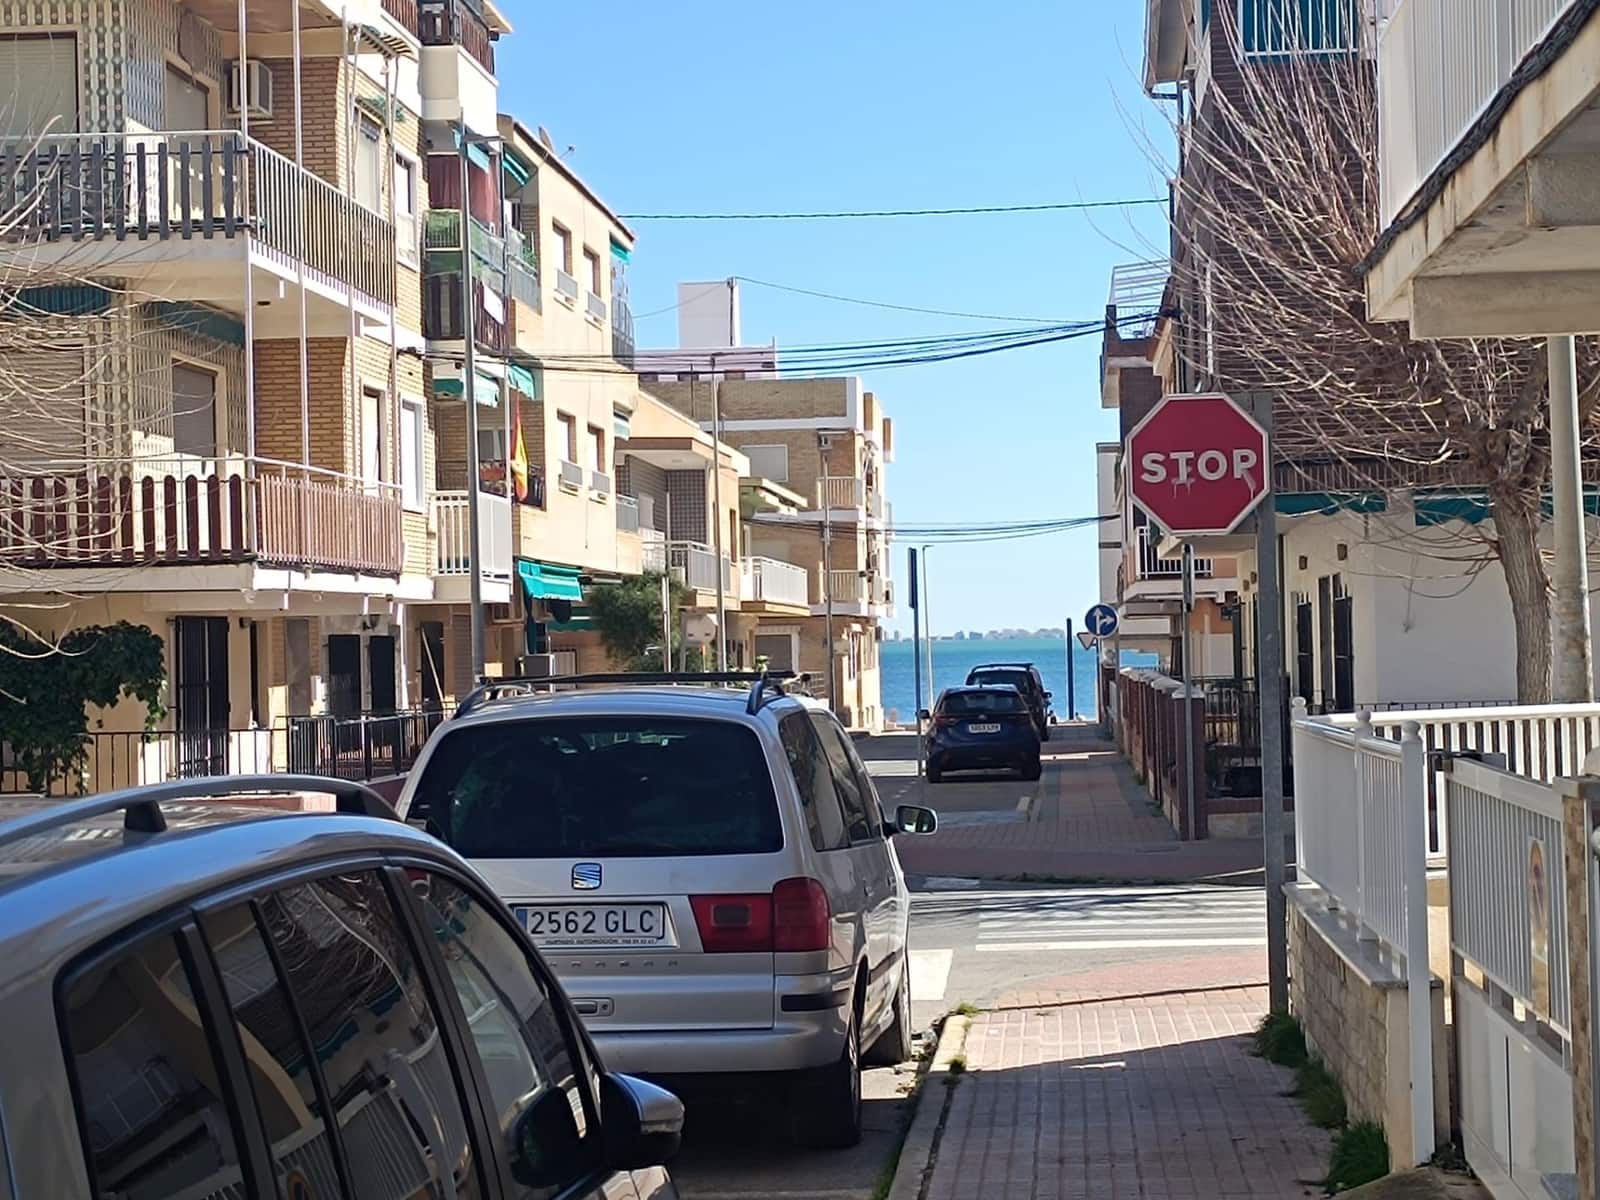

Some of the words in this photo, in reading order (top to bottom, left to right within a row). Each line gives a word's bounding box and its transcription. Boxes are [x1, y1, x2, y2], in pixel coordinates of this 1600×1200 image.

[1140, 449, 1257, 484] STOP
[531, 911, 596, 934] 2562
[605, 910, 654, 933] GLC
